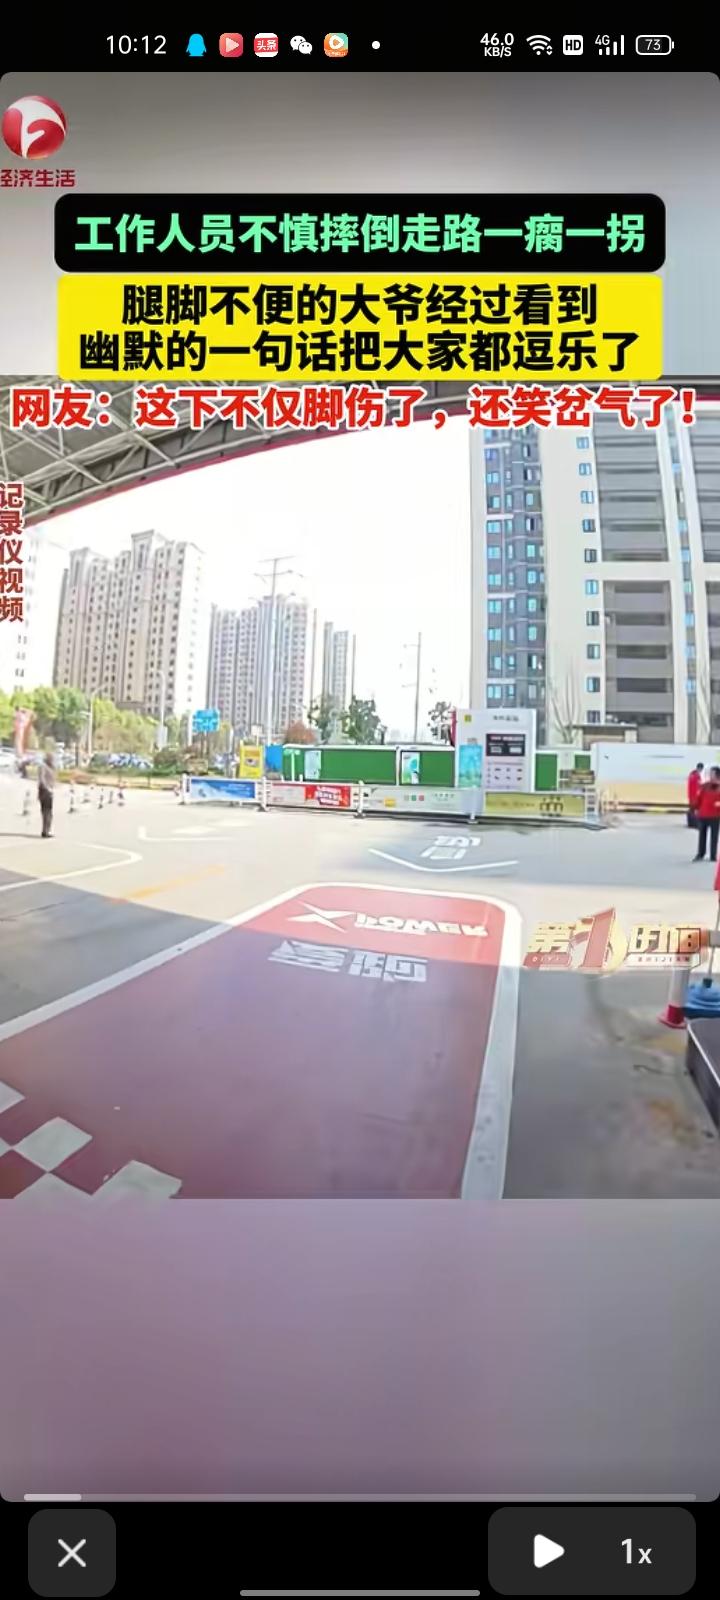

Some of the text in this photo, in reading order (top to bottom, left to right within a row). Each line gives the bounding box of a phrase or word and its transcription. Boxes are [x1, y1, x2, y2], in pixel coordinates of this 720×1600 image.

[106, 34, 167, 55] 10:12
[256, 39, 277, 52] 头条
[480, 32, 515, 46] 46.0
[565, 39, 582, 51] HD
[594, 34, 610, 46] 4G
[645, 38, 662, 51] 73
[484, 46, 512, 58] KB/S
[621, 1538, 652, 1564] 1x
